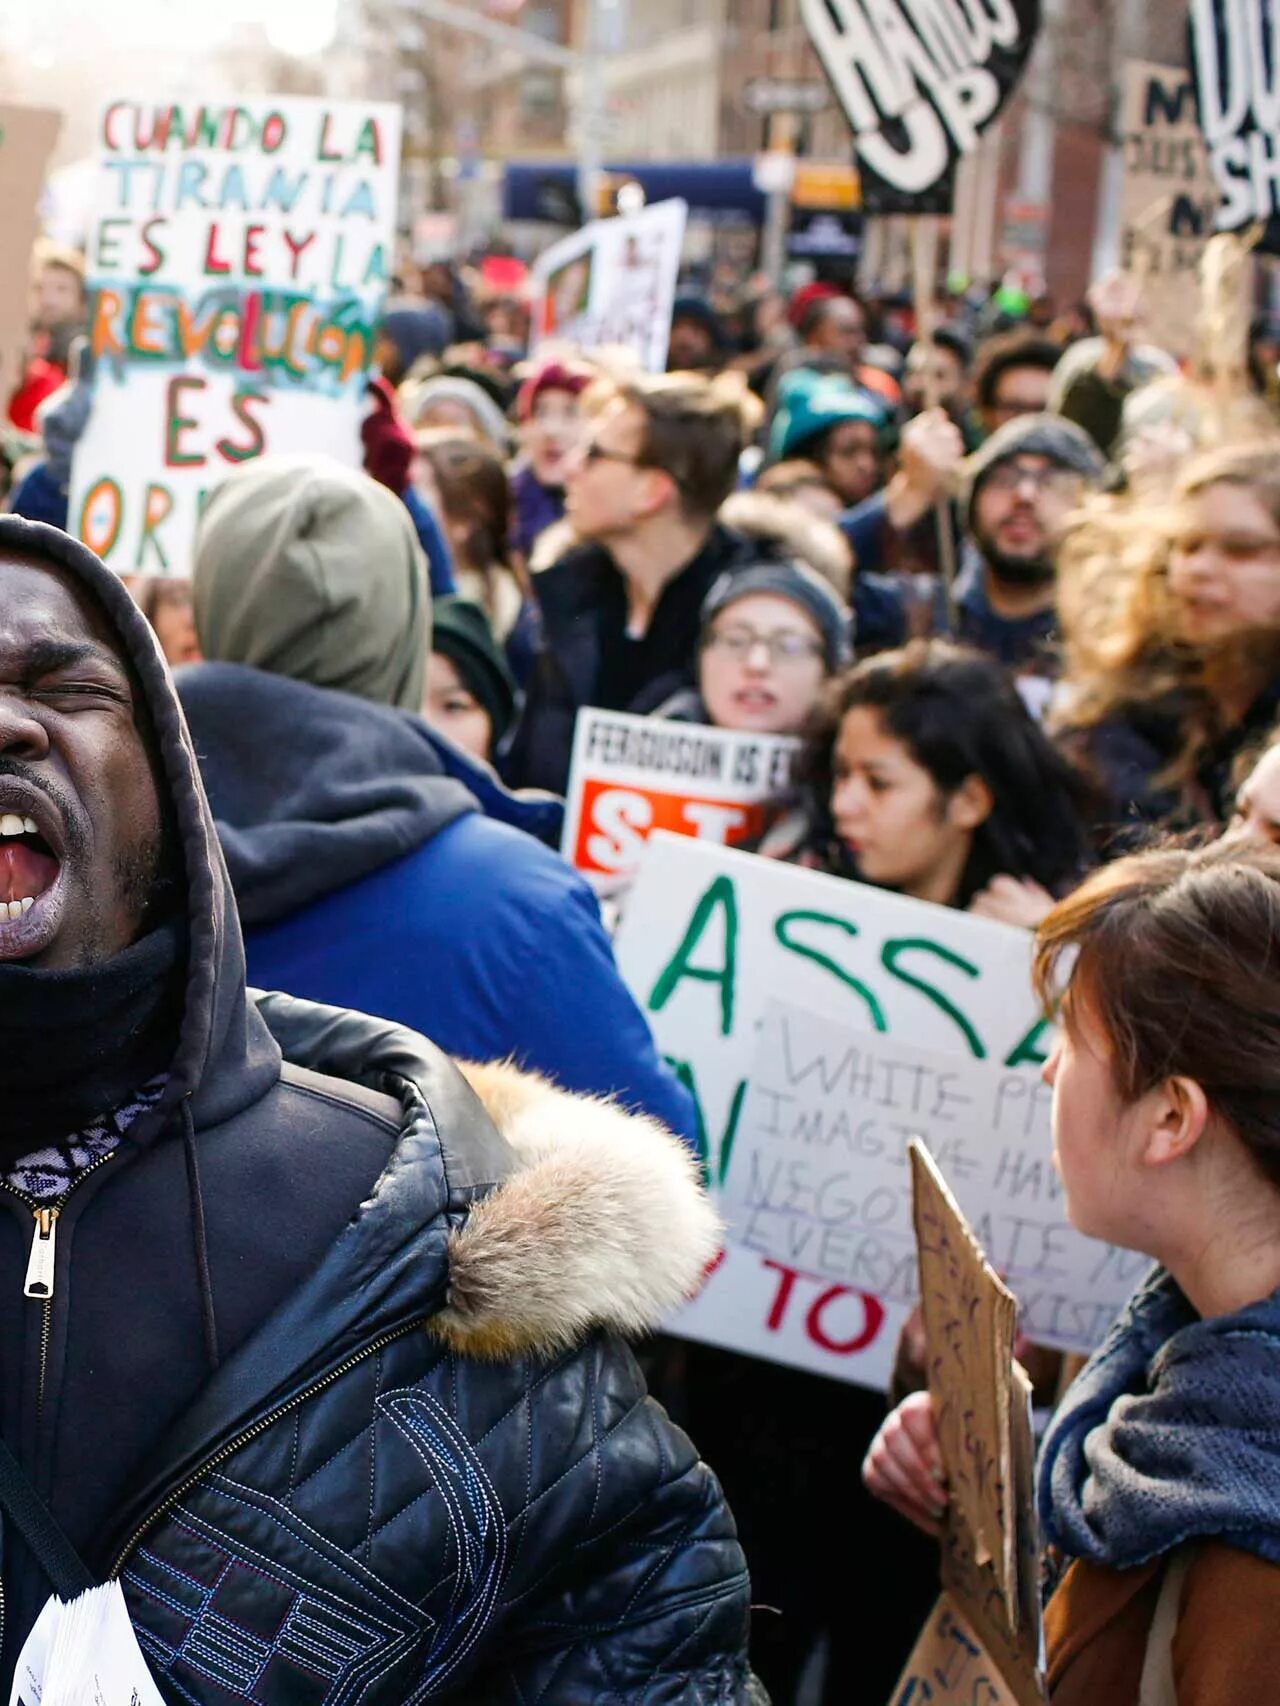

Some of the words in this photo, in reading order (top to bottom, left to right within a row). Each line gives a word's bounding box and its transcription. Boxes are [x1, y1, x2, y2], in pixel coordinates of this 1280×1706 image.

[102, 101, 286, 153] CUANDO
[317, 112, 383, 167] LA
[857, 66, 1012, 193] UP
[97, 216, 167, 277] ES
[328, 232, 393, 293] LA
[163, 373, 271, 468] ES
[80, 474, 208, 568] OR
[587, 721, 726, 780] FERGUSON
[731, 740, 761, 784] IS
[585, 788, 747, 872] ST
[779, 1014, 975, 1122] WHITE
[761, 1256, 887, 1357] TO
